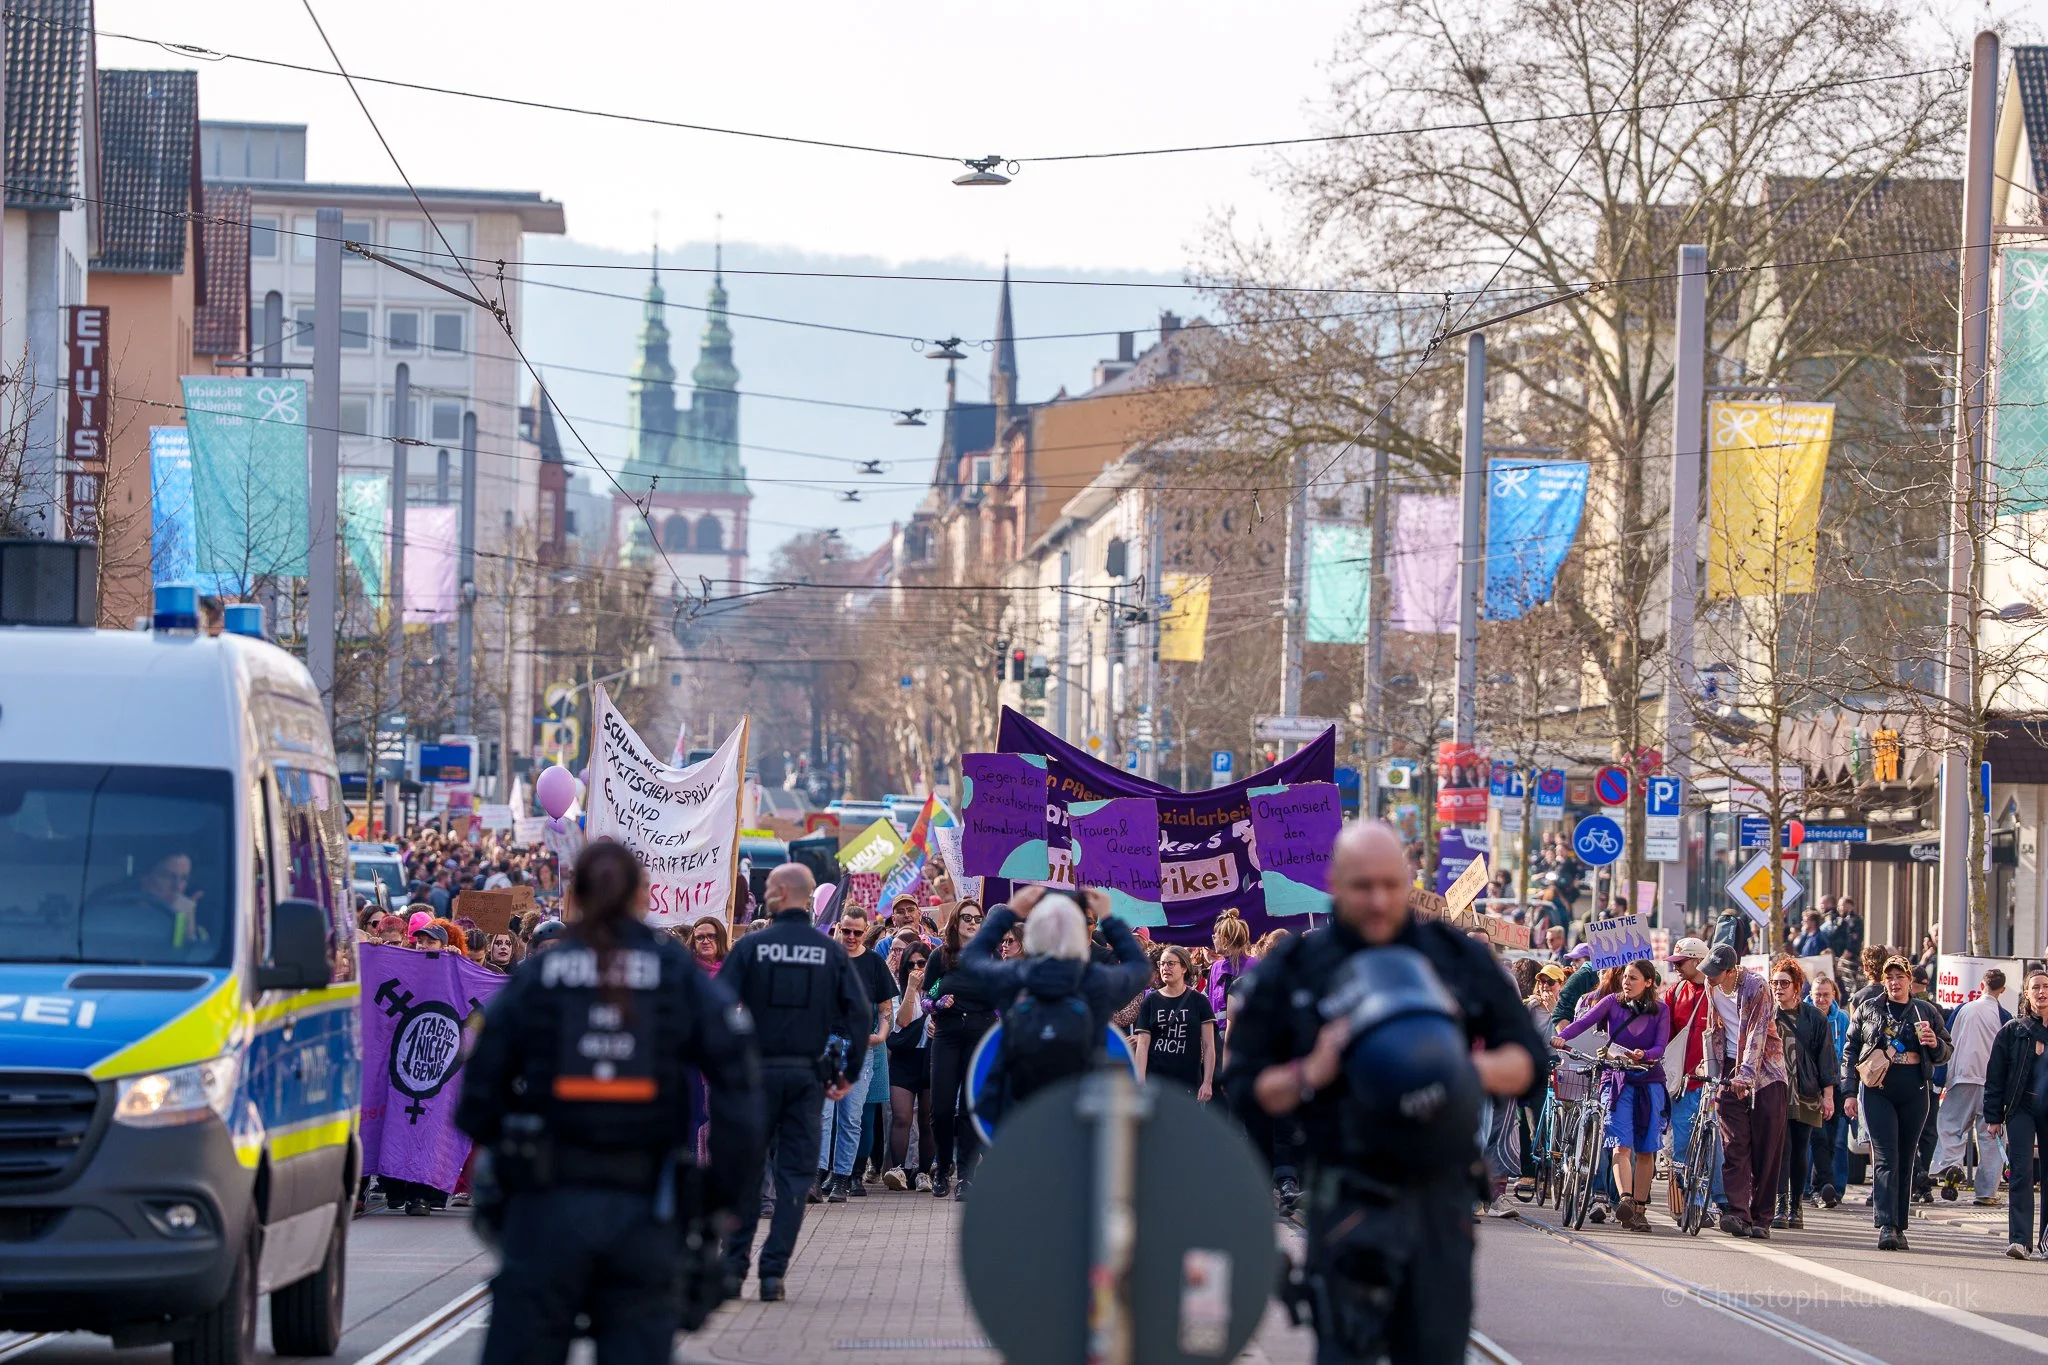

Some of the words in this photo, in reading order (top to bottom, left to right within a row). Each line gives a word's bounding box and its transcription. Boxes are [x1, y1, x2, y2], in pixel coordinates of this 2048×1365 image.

[74, 309, 101, 457] ETUIS
[976, 765, 1018, 788] Gegen
[1021, 767, 1041, 788] den
[1654, 781, 1674, 812] P
[629, 798, 661, 821] UND
[1258, 795, 1331, 823] Organisiert
[973, 818, 1044, 839] Normalzustand
[1071, 818, 1118, 838] Frauen
[1284, 823, 1306, 840] den
[1805, 828, 1865, 840] stendstraße
[1106, 838, 1153, 857] Queers
[2021, 844, 2035, 853] 58
[675, 879, 717, 912] MIT
[1589, 920, 1616, 933] BURN
[1619, 915, 1638, 927] THE
[756, 943, 827, 966] POLIZEI
[1595, 948, 1652, 969] PATRIARCHY
[1938, 971, 1959, 986] Kein
[1938, 989, 1964, 1003] Platz
[1157, 1009, 1189, 1023] EAT
[420, 1016, 447, 1036] TAG
[444, 1026, 458, 1044] IST
[1158, 1023, 1188, 1038] THE
[415, 1035, 455, 1063] NICHT
[1154, 1038, 1186, 1054] RICH
[413, 1060, 445, 1082] GENUG
